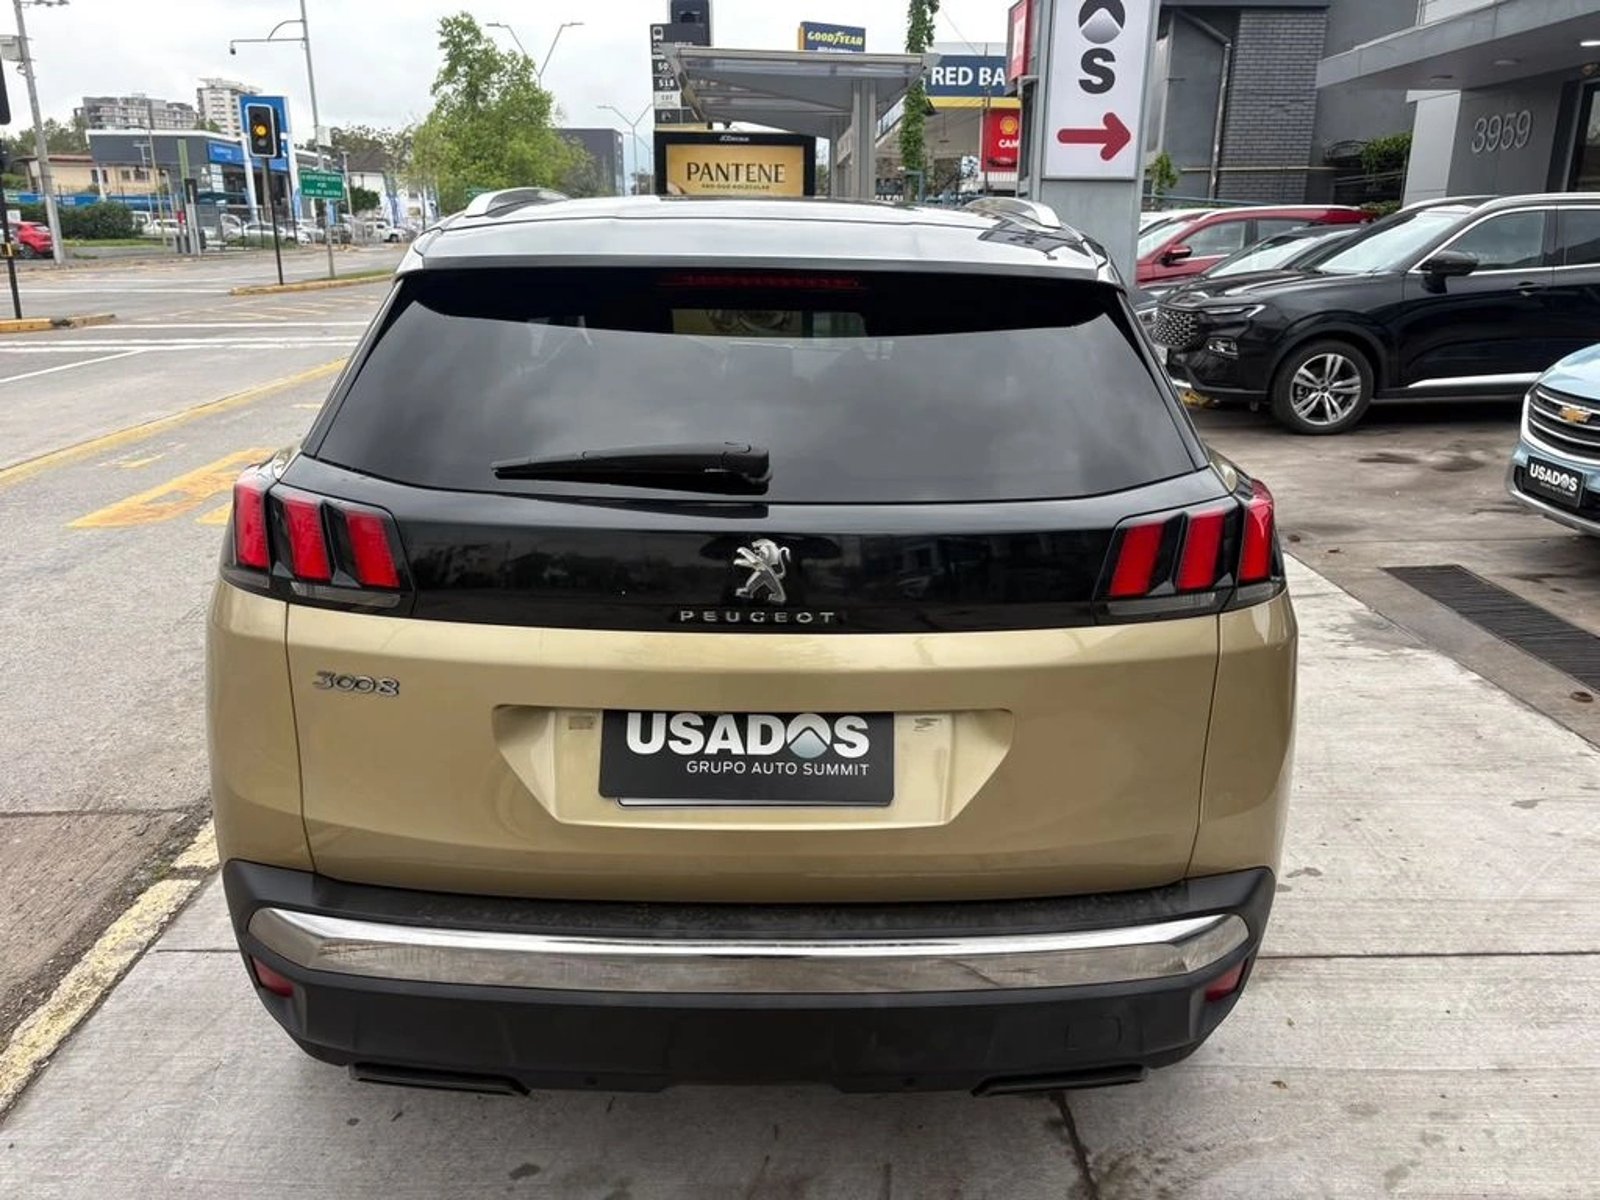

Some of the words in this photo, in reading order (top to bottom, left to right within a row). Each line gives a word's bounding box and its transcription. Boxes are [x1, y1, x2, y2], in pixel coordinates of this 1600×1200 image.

[807, 31, 863, 46] GOODYEAR
[931, 66, 973, 86] RED
[1471, 110, 1531, 153] 3959
[686, 162, 786, 184] PANTENE
[1530, 463, 1578, 491] USADOS
[680, 610, 835, 623] PEUGEOT
[312, 670, 400, 697] 3008
[626, 711, 870, 759] USADOS
[686, 760, 747, 774] GRUPO
[751, 761, 798, 776] AUTO
[802, 762, 870, 777] SUMMIT
